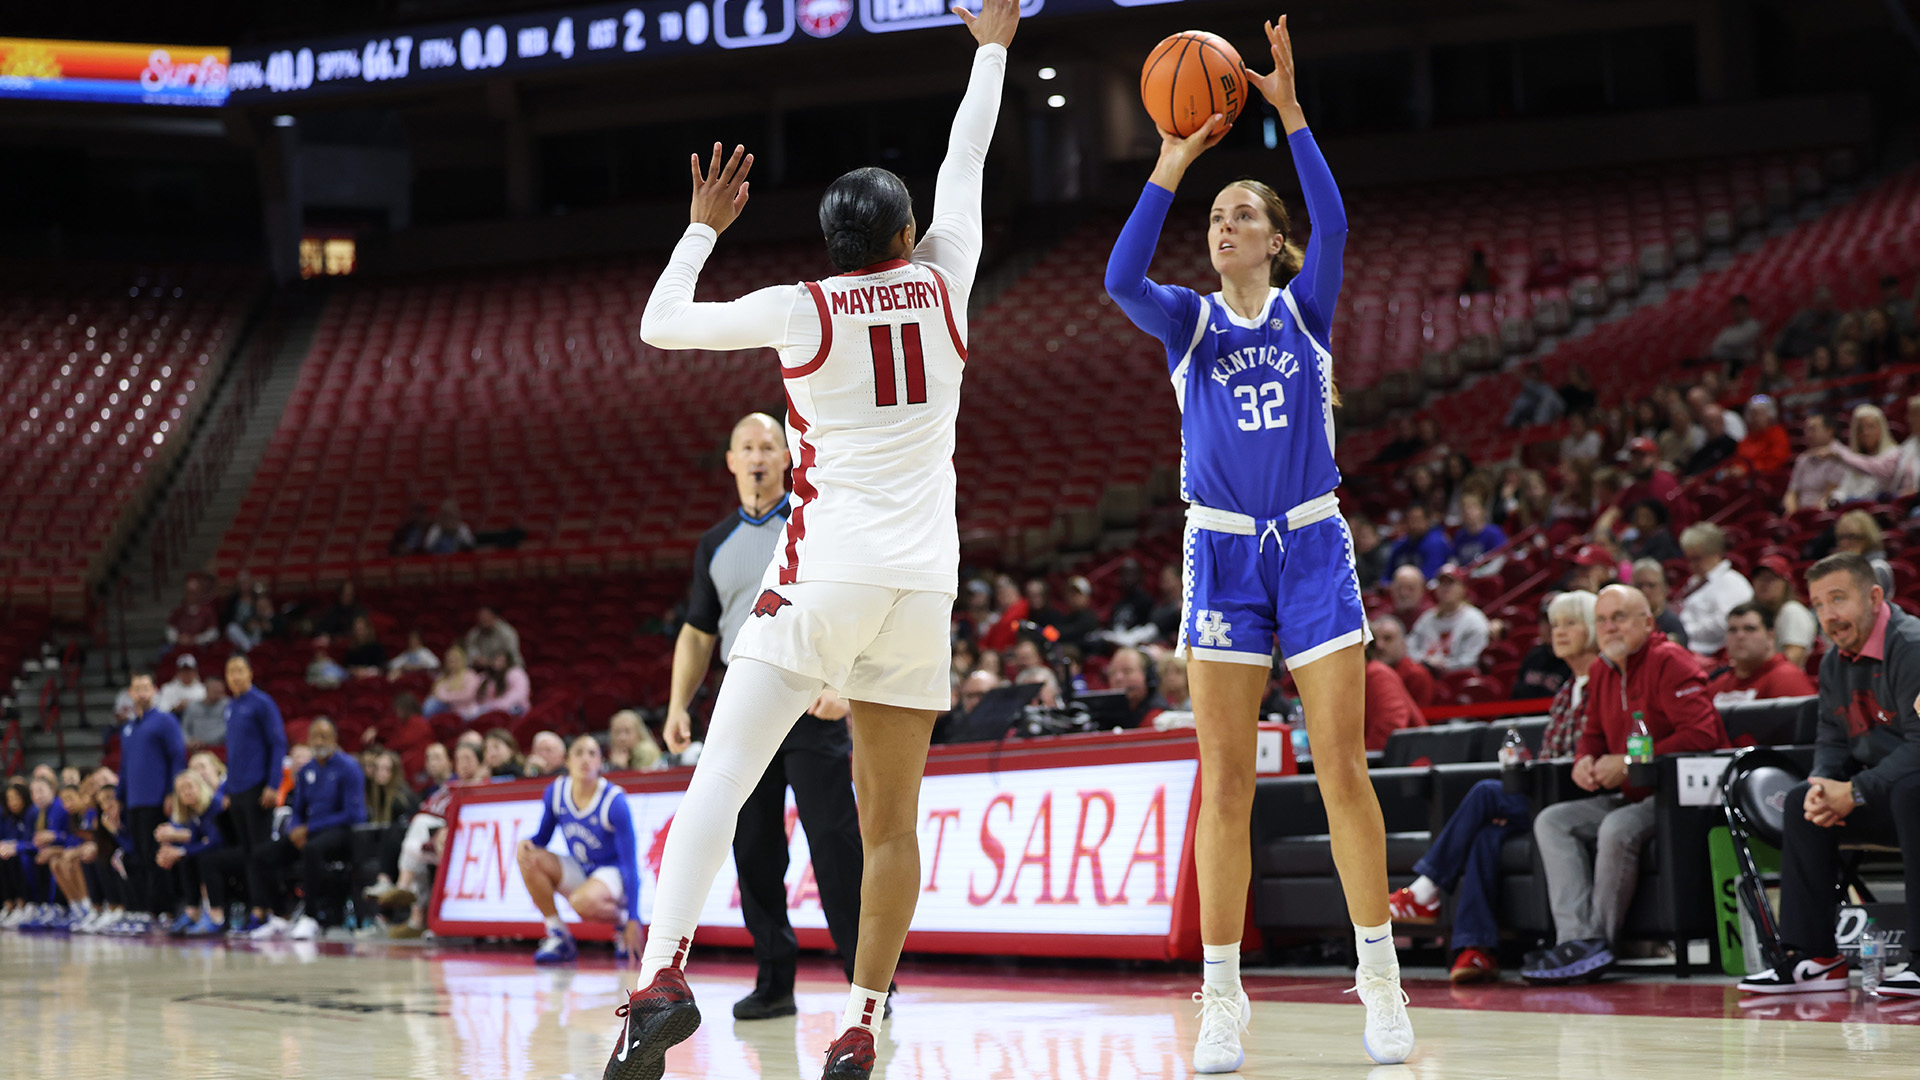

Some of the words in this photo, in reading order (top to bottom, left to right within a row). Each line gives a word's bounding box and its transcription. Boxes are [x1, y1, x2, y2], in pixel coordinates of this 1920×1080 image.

[362, 36, 413, 81] 66.7
[460, 25, 507, 70] 0.0
[552, 17, 575, 59] 4
[623, 8, 646, 52] 2
[831, 281, 939, 315] MAYBERRY
[868, 322, 927, 407] 11
[1211, 345, 1300, 386] KENTUCKY
[1234, 381, 1288, 431] 32
[967, 784, 1174, 907] SARA
